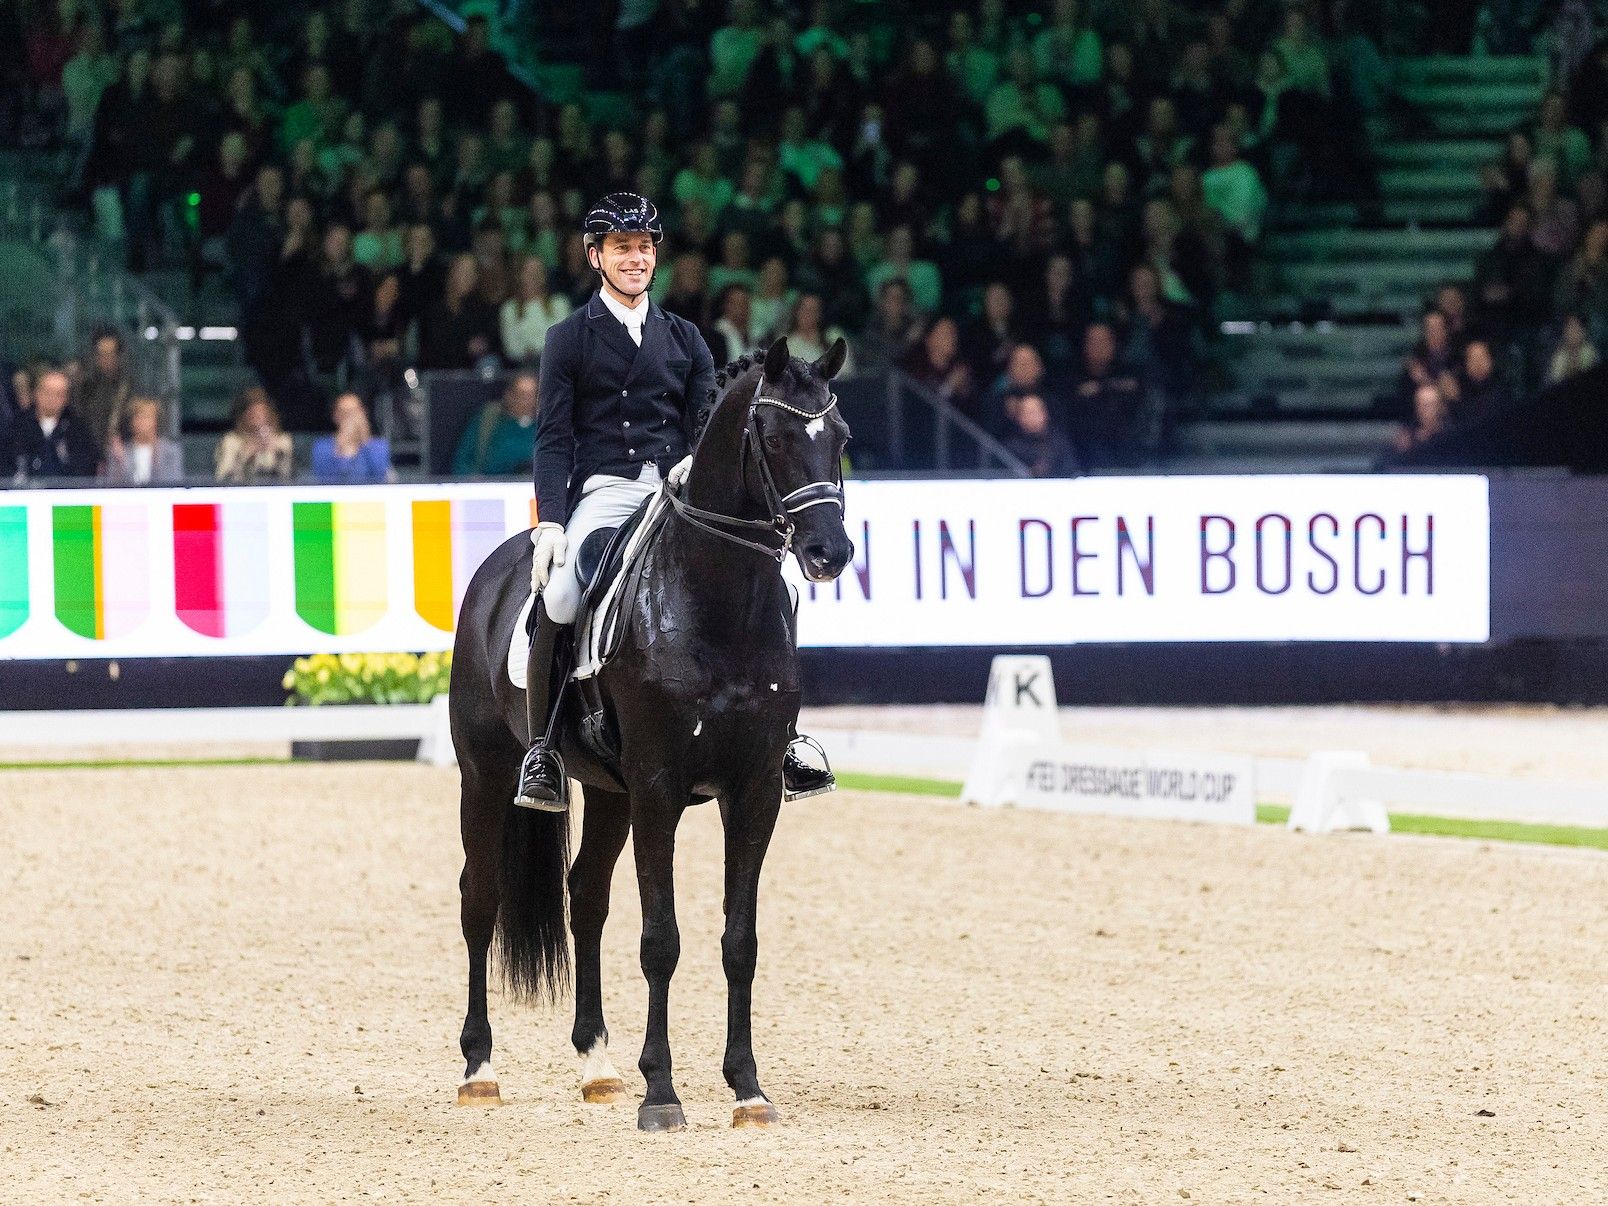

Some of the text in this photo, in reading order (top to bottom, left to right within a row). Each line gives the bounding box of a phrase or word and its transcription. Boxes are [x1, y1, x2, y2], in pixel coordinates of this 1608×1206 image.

[913, 519, 976, 600] IN
[1020, 516, 1154, 598] DEN
[1200, 513, 1433, 596] BOSCH
[1014, 672, 1042, 706] K
[1146, 767, 1197, 800] WORLD
[1201, 769, 1236, 802] CUP
